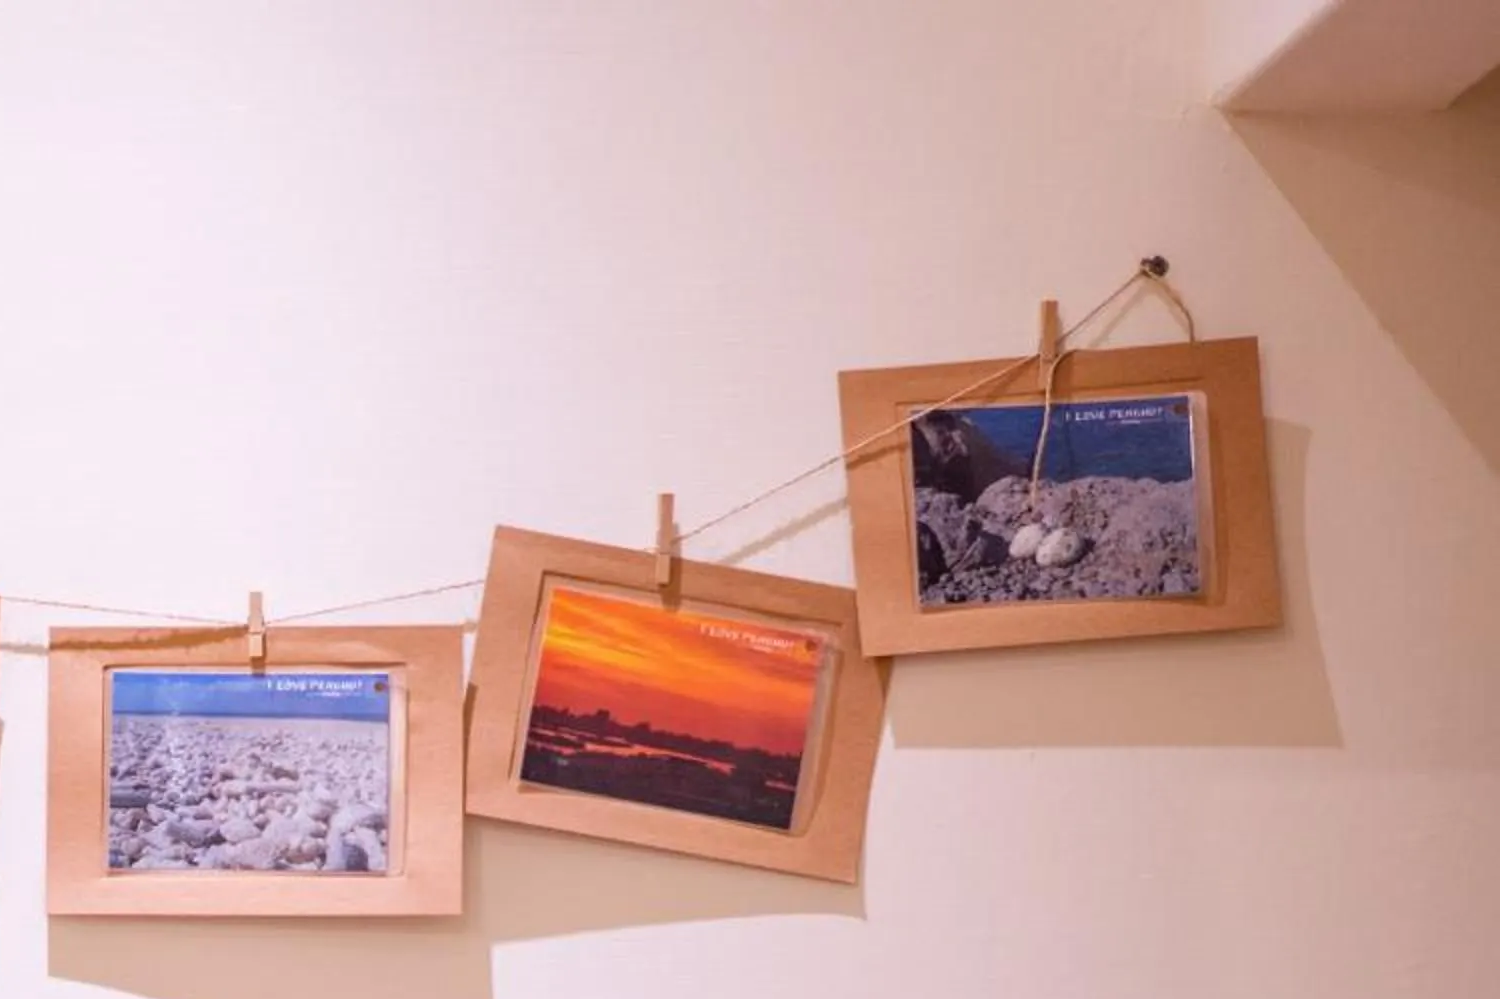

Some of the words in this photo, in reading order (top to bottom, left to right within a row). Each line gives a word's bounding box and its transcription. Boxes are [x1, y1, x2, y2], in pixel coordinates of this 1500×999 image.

[1075, 410, 1105, 421] LOVE
[709, 626, 738, 640] LOVE
[276, 679, 306, 691] LOVE
